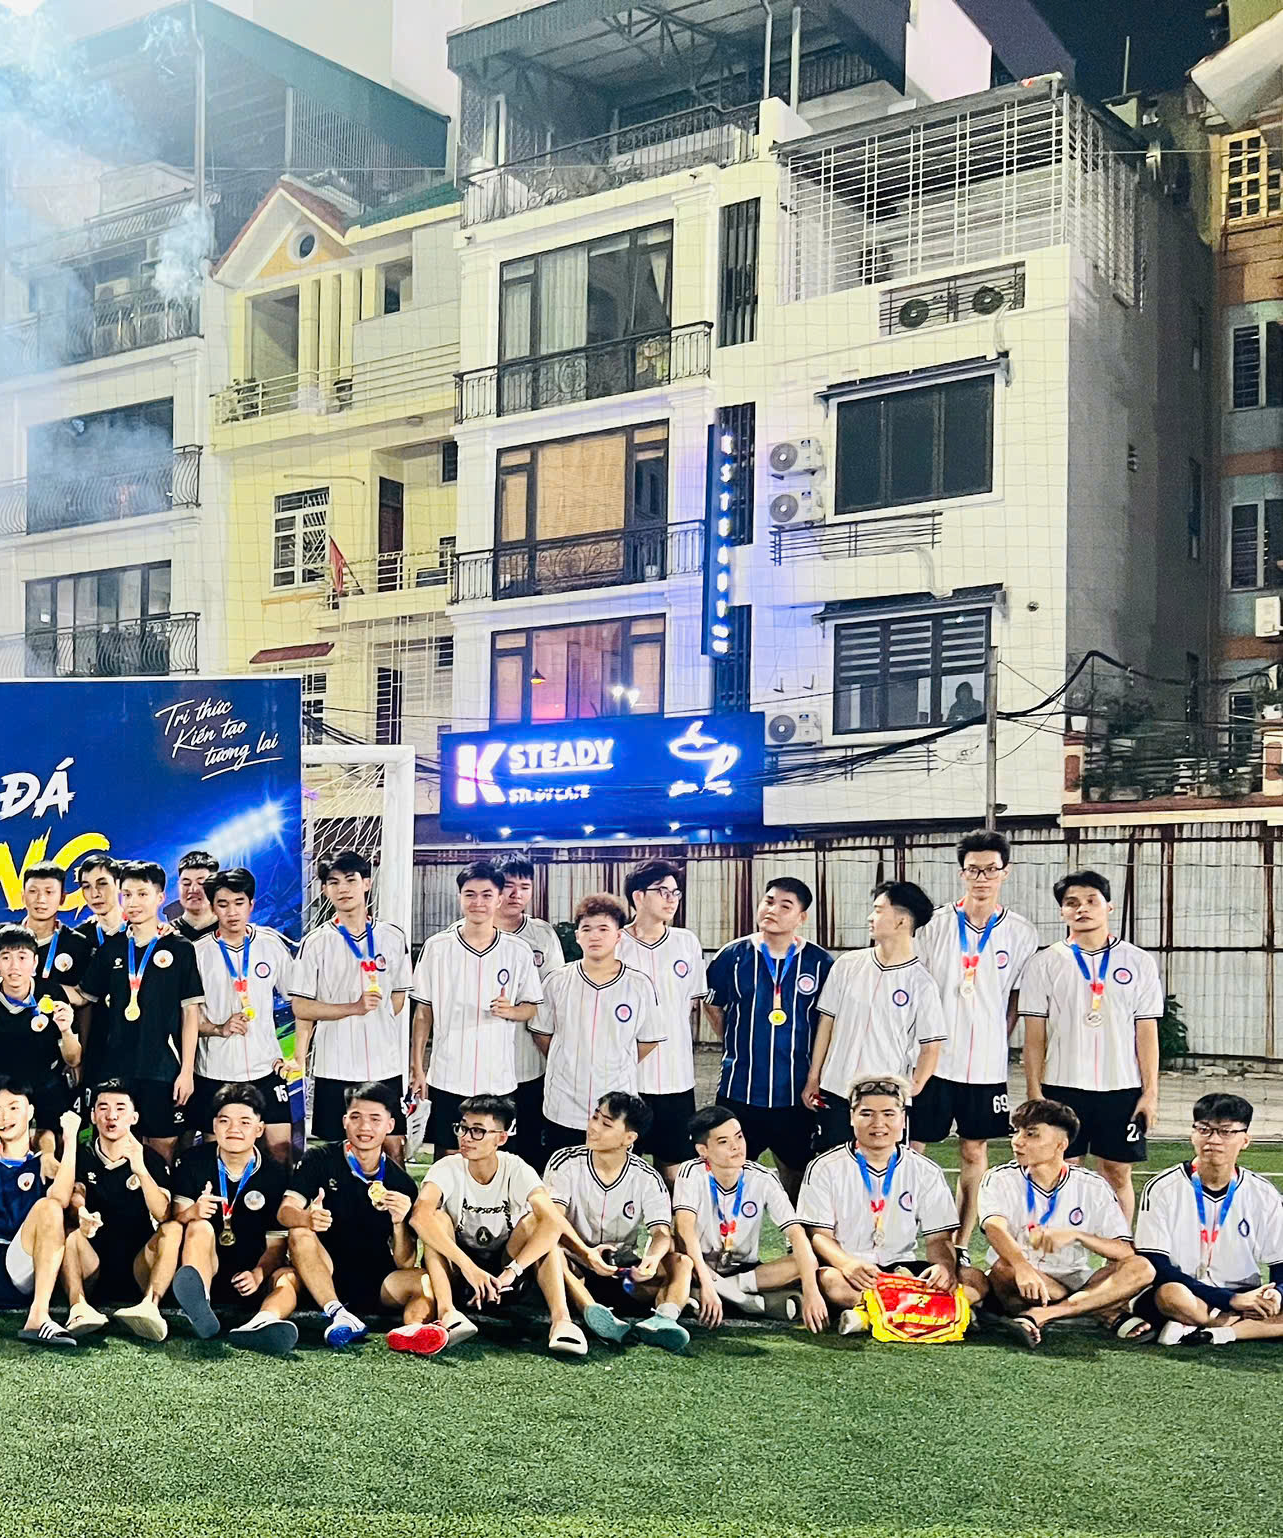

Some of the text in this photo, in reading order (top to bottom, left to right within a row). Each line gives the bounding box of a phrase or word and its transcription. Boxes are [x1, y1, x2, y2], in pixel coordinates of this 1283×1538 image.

[193, 697, 234, 722] thức
[171, 717, 248, 759] Kiến tạo
[255, 730, 279, 754] lai
[457, 739, 615, 804] K STEADY
[273, 1084, 289, 1103] 15
[992, 1094, 1010, 1114] 69
